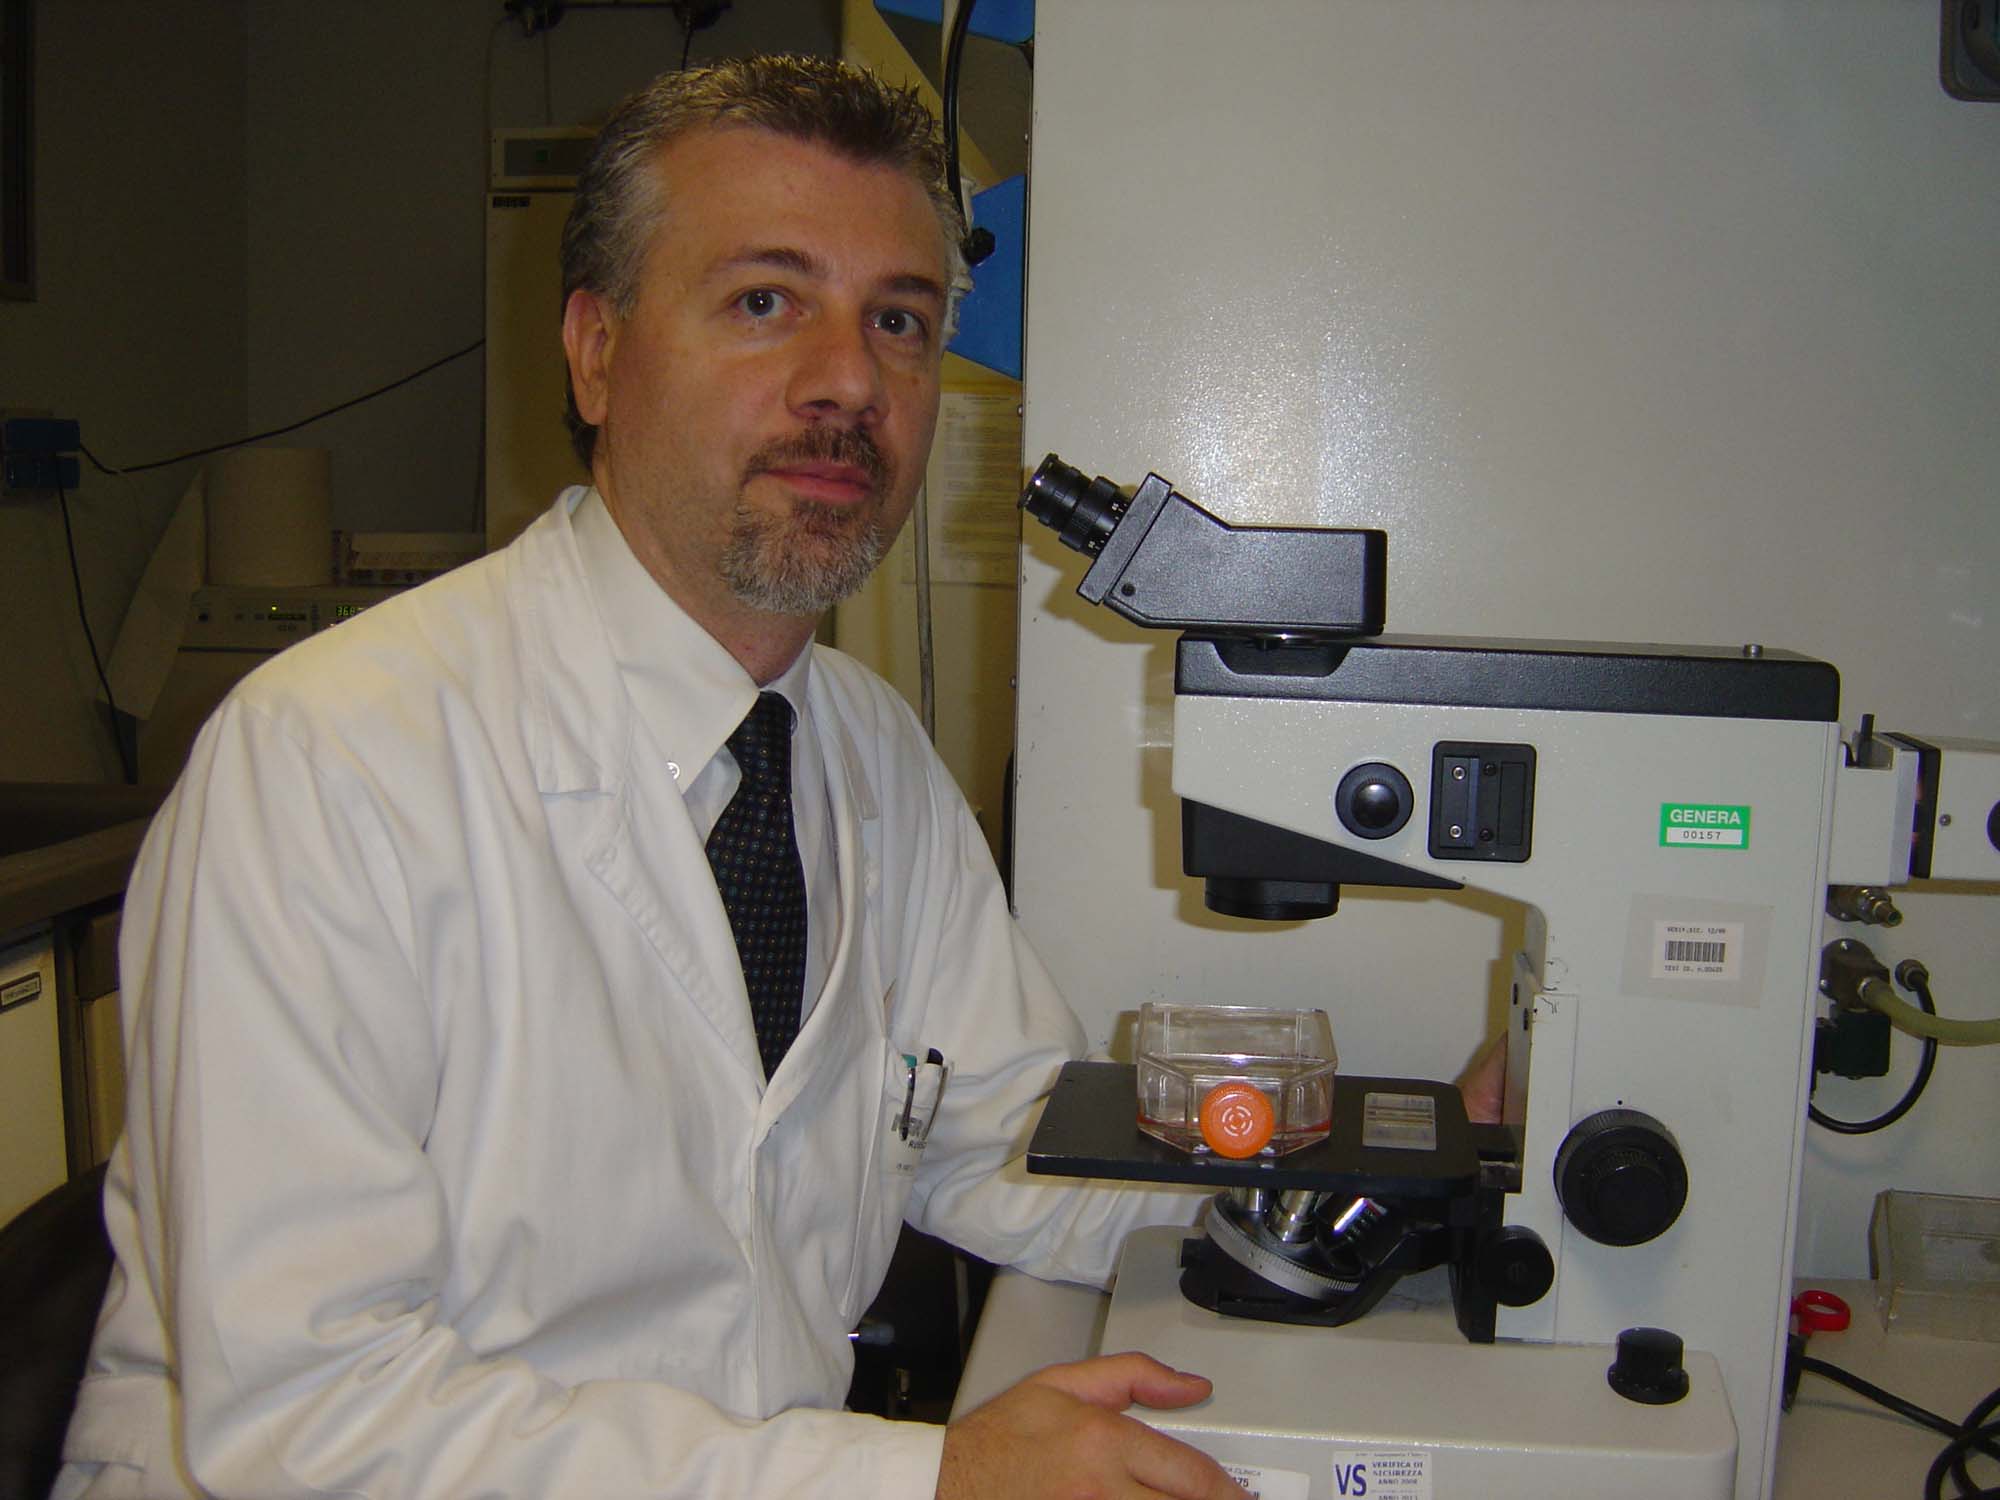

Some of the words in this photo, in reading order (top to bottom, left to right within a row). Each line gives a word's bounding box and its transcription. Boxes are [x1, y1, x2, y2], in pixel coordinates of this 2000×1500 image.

[1670, 808, 1741, 825] GENERA
[1683, 830, 1722, 841] 00157
[1372, 1461, 1410, 1469] VERIFICA
[1413, 1461, 1424, 1469] DI
[1372, 1469, 1423, 1477] SICUREZZA
[1335, 1463, 1367, 1497] VS
